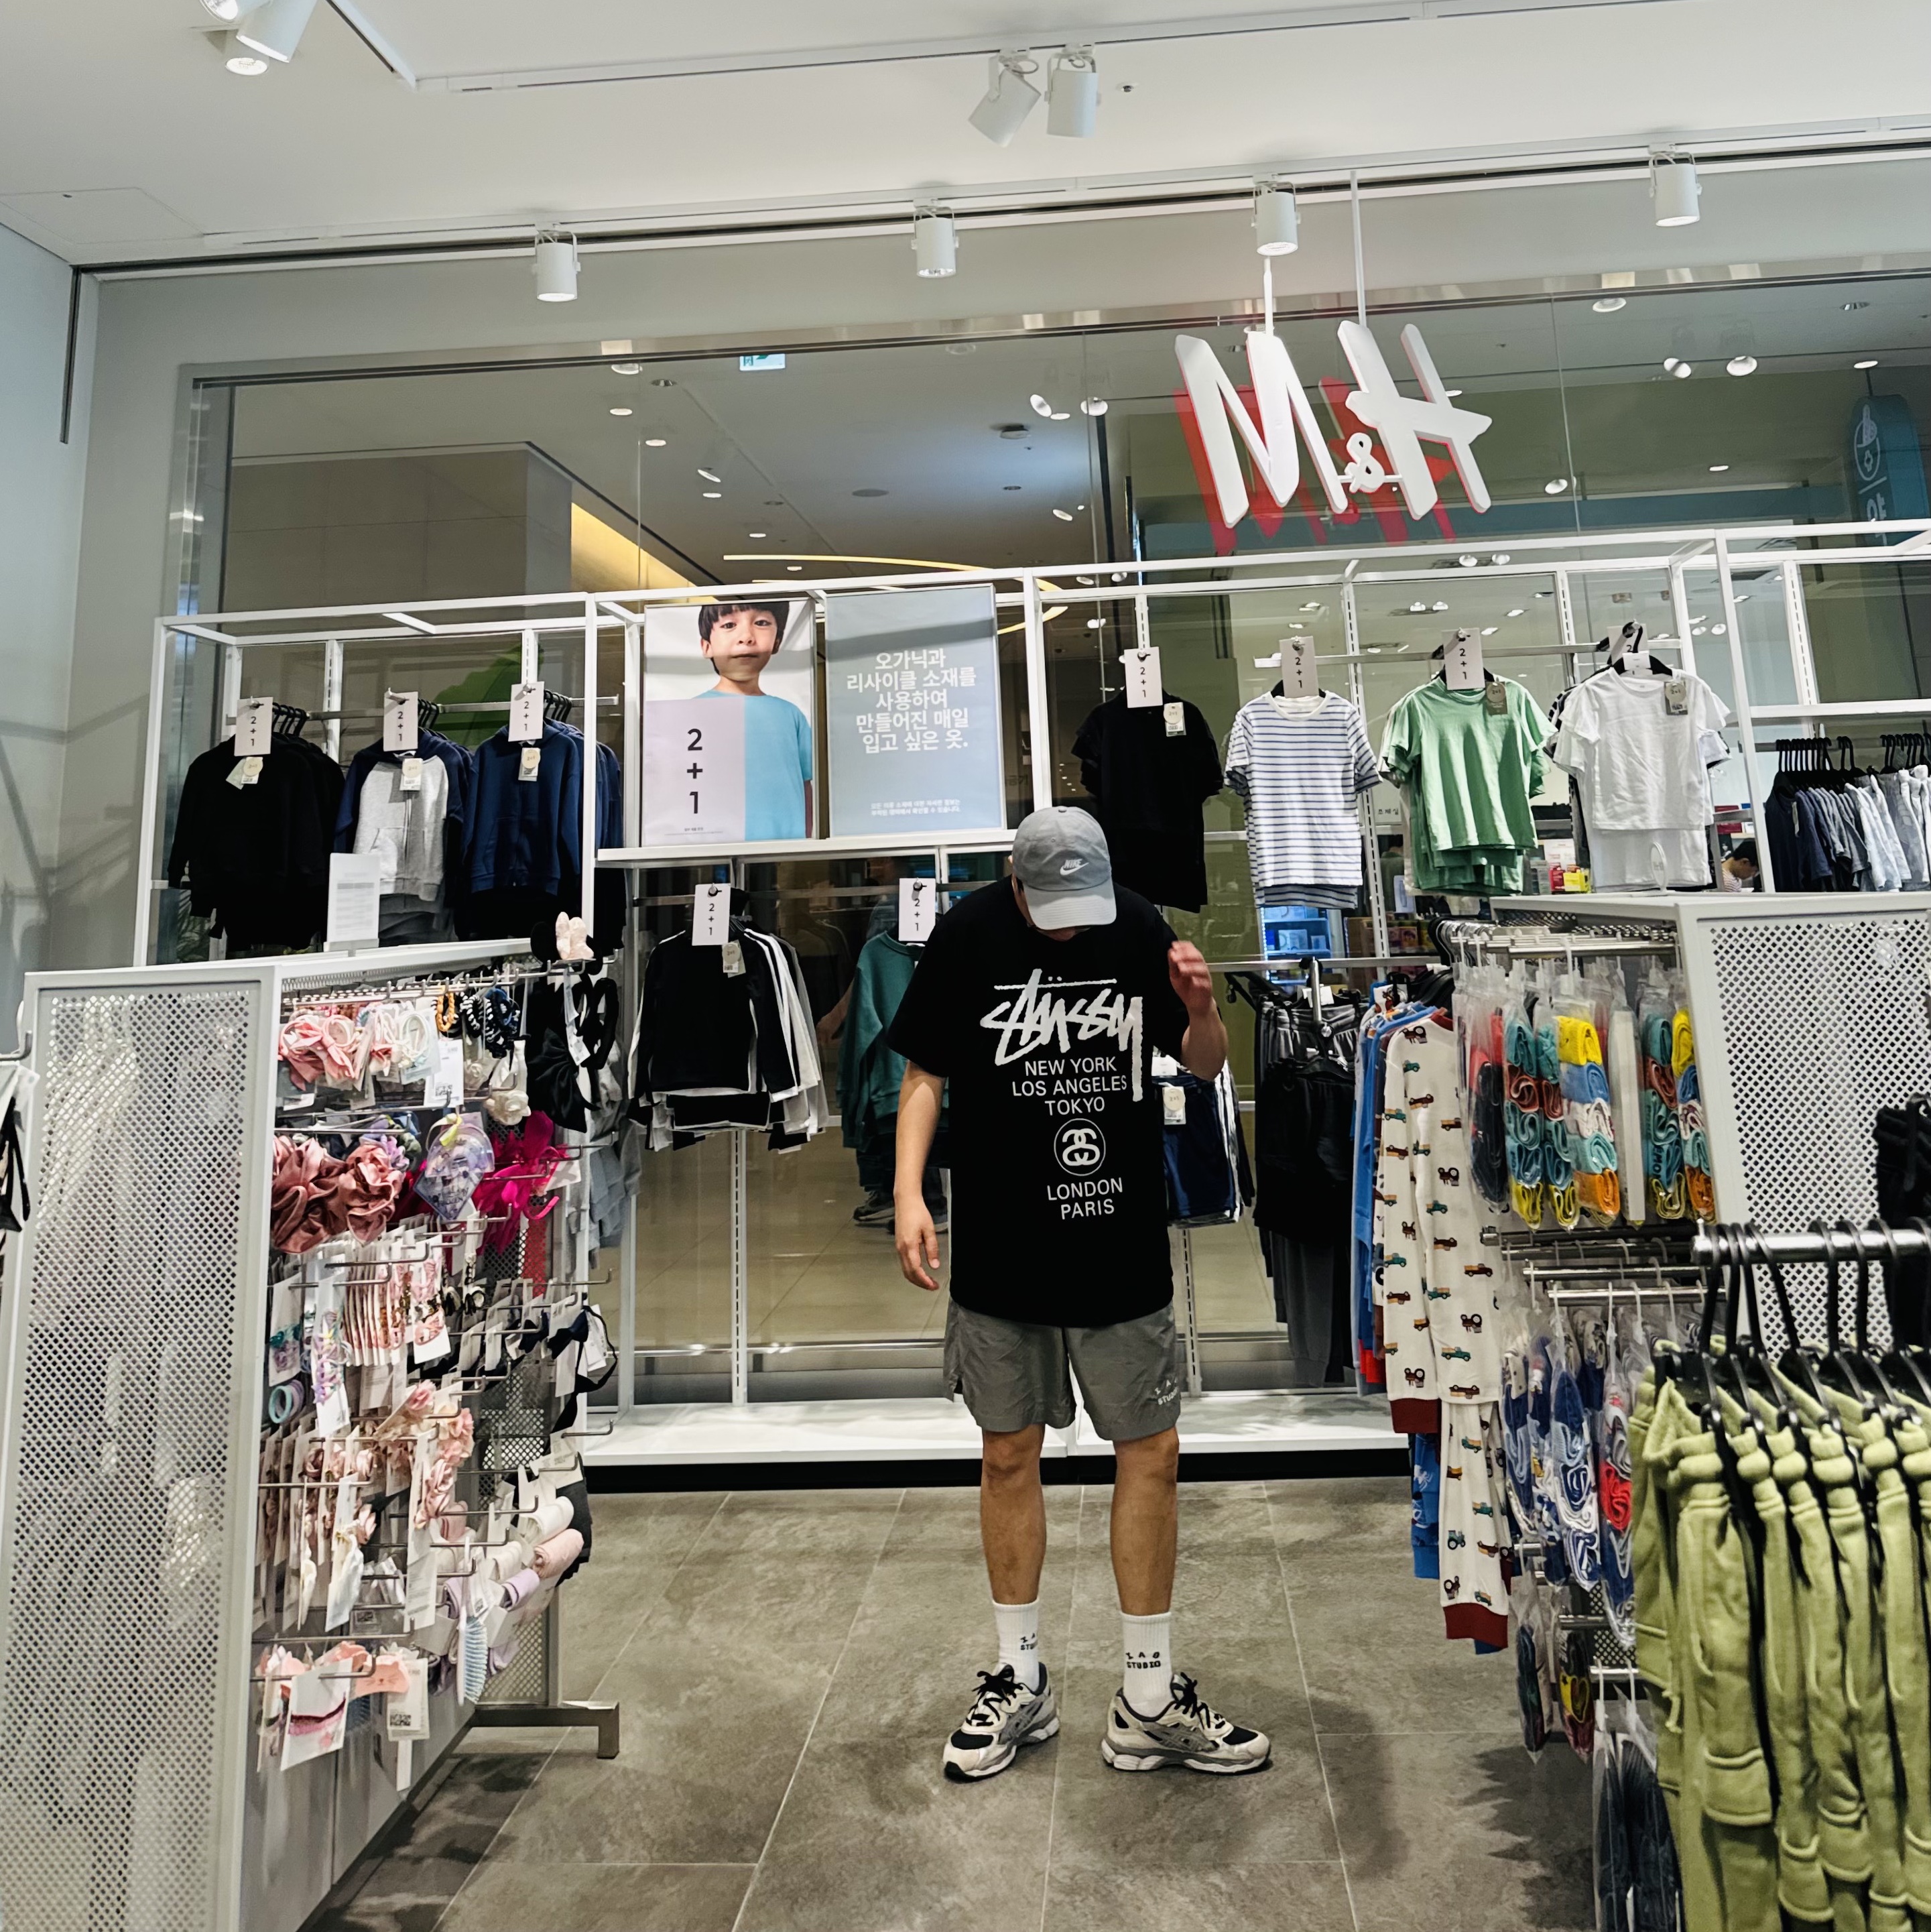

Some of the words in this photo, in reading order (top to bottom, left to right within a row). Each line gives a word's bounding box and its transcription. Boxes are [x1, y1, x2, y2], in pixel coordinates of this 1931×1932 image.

[875, 648, 946, 670] 오가닉과
[847, 670, 917, 693] 리사이클
[922, 666, 977, 687] 소재를
[876, 688, 947, 711] 사용하여
[856, 710, 928, 733] 만들어진
[934, 707, 969, 729] 매일
[863, 733, 899, 753] 입고
[904, 731, 940, 751] 싶은
[945, 729, 969, 749] 옷.
[1063, 859, 1082, 869] NIKE
[1025, 1059, 1065, 1076] NEW
[1070, 1056, 1117, 1073] YORK
[1012, 1081, 1047, 1096] LOS
[1052, 1075, 1127, 1095] ANGELES
[1044, 1096, 1105, 1116] TOKYO
[1047, 1178, 1123, 1201] LONDON
[1060, 1199, 1115, 1219] PARIS
[1127, 1661, 1161, 1669] STUDIO
